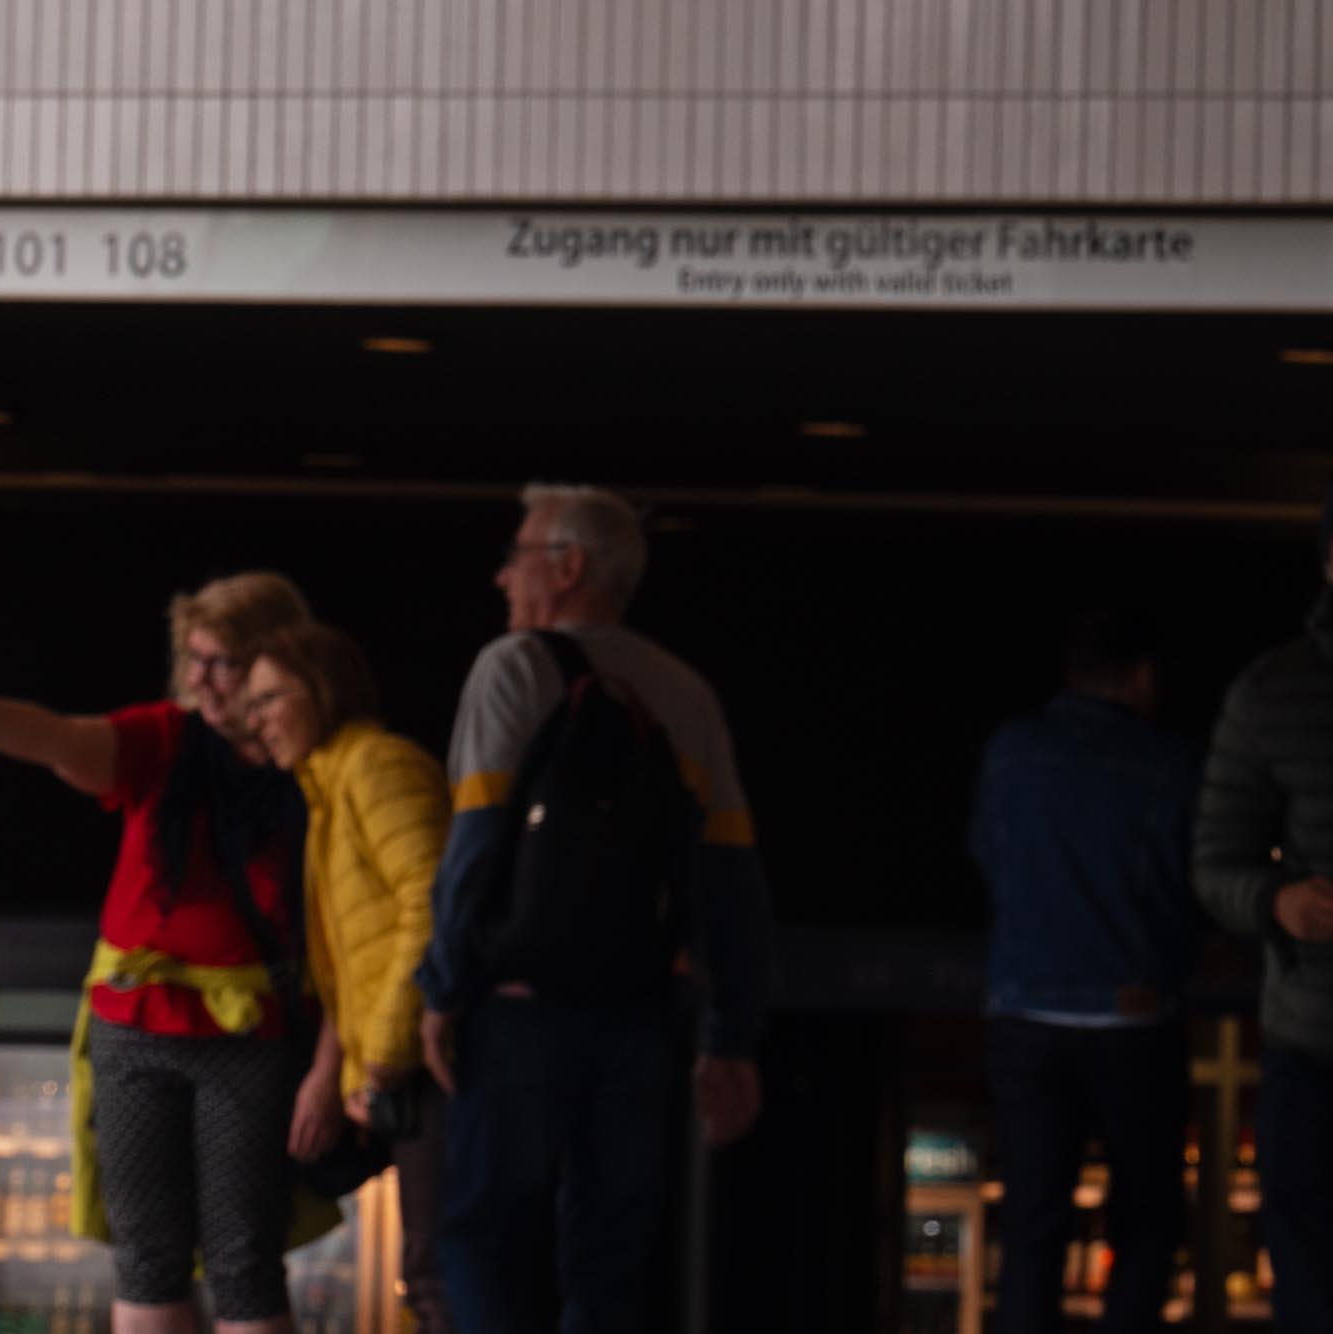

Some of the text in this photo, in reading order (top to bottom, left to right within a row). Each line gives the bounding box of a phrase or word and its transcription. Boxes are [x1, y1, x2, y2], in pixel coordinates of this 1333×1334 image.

[104, 230, 189, 280] 108
[506, 215, 1195, 271] Zugang nur mit gültiger Fahrkarte
